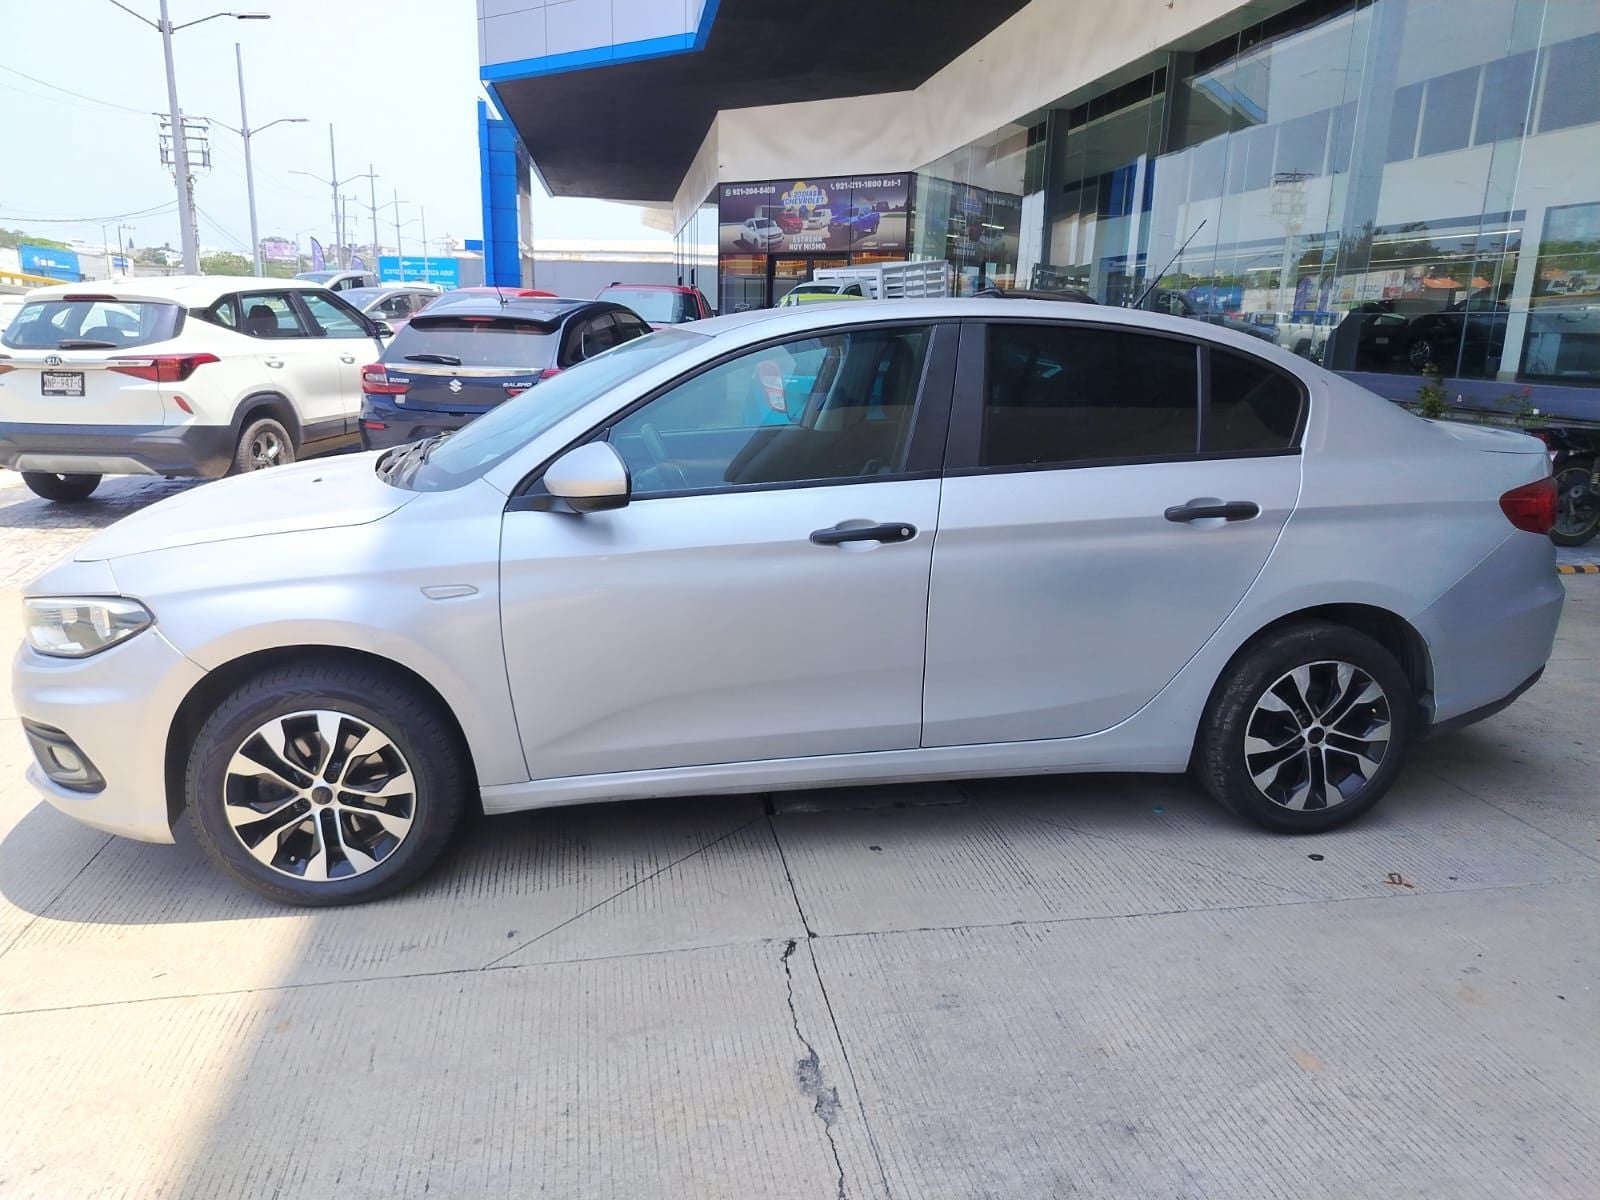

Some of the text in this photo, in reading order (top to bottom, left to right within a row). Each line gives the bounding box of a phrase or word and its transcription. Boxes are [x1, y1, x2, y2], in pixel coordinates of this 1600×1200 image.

[784, 196, 824, 205] CHEVROLET
[792, 235, 823, 243] ESTRENA
[803, 242, 827, 250] MISMO
[47, 356, 61, 365] KIA
